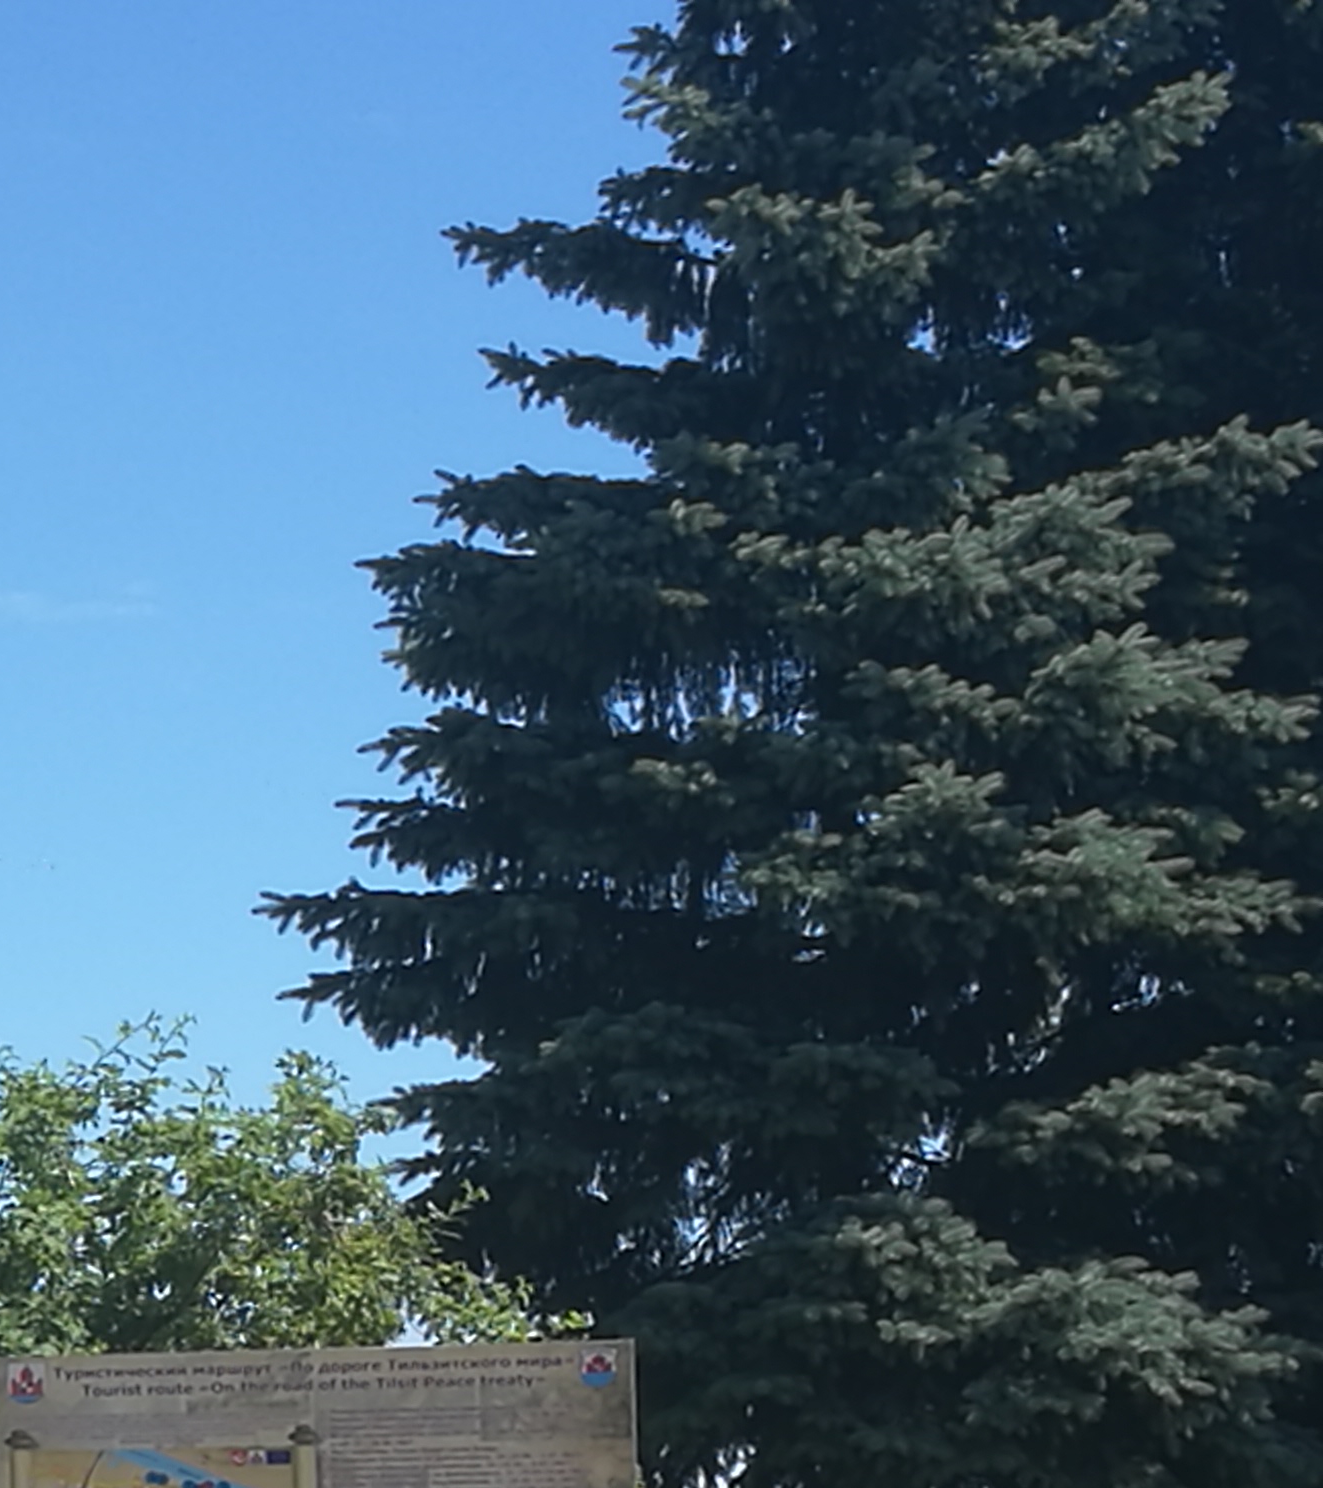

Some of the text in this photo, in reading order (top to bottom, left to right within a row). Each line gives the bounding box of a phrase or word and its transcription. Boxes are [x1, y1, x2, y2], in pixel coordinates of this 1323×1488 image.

[318, 1361, 382, 1374] дороге
[83, 1383, 143, 1397] Tourist
[147, 1382, 193, 1396] route
[240, 1380, 269, 1393] the
[274, 1378, 313, 1392] road
[318, 1377, 337, 1391] of
[341, 1377, 370, 1390] the
[377, 1376, 418, 1389] Tilsit
[423, 1375, 476, 1388] Peace
